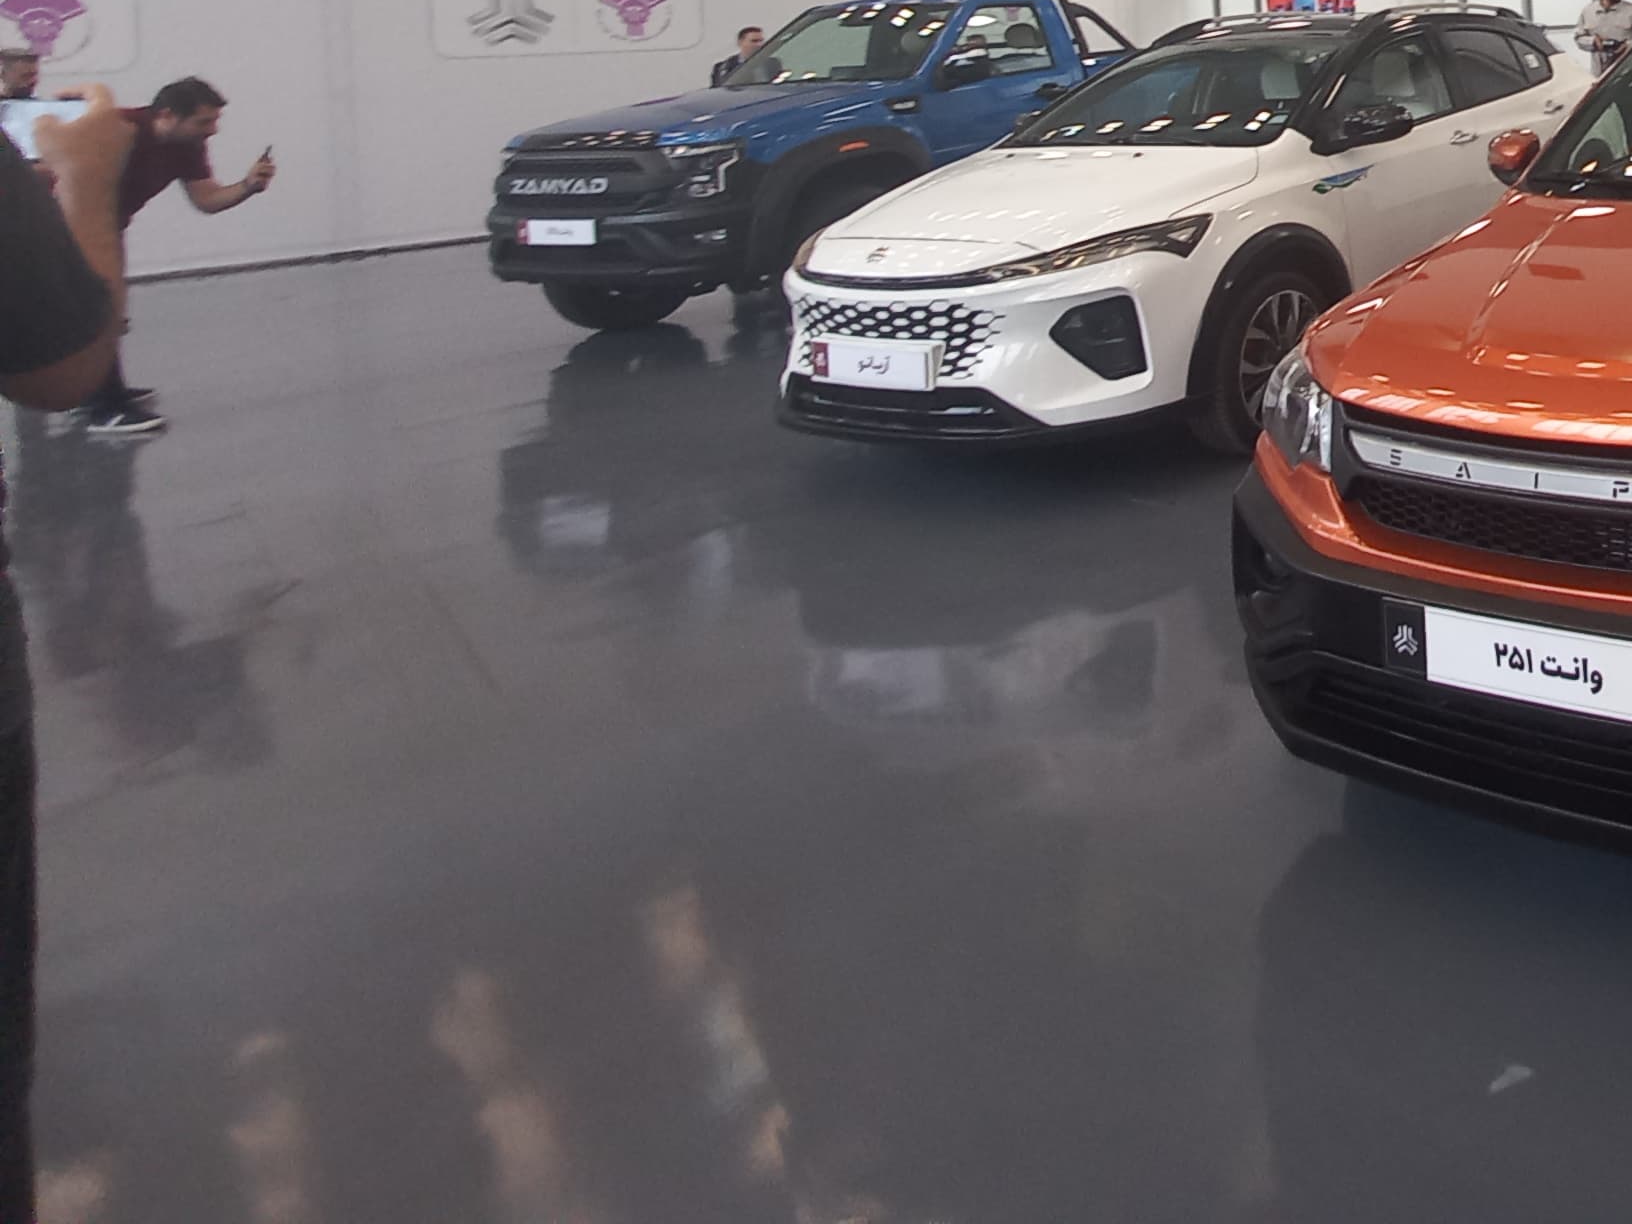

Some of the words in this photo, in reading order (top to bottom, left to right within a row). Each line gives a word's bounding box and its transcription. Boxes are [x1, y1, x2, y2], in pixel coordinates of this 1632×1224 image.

[509, 177, 609, 195] ZAMYAD
[1493, 642, 1534, 673] ۲۵۱
[1540, 656, 1604, 694] وانت
